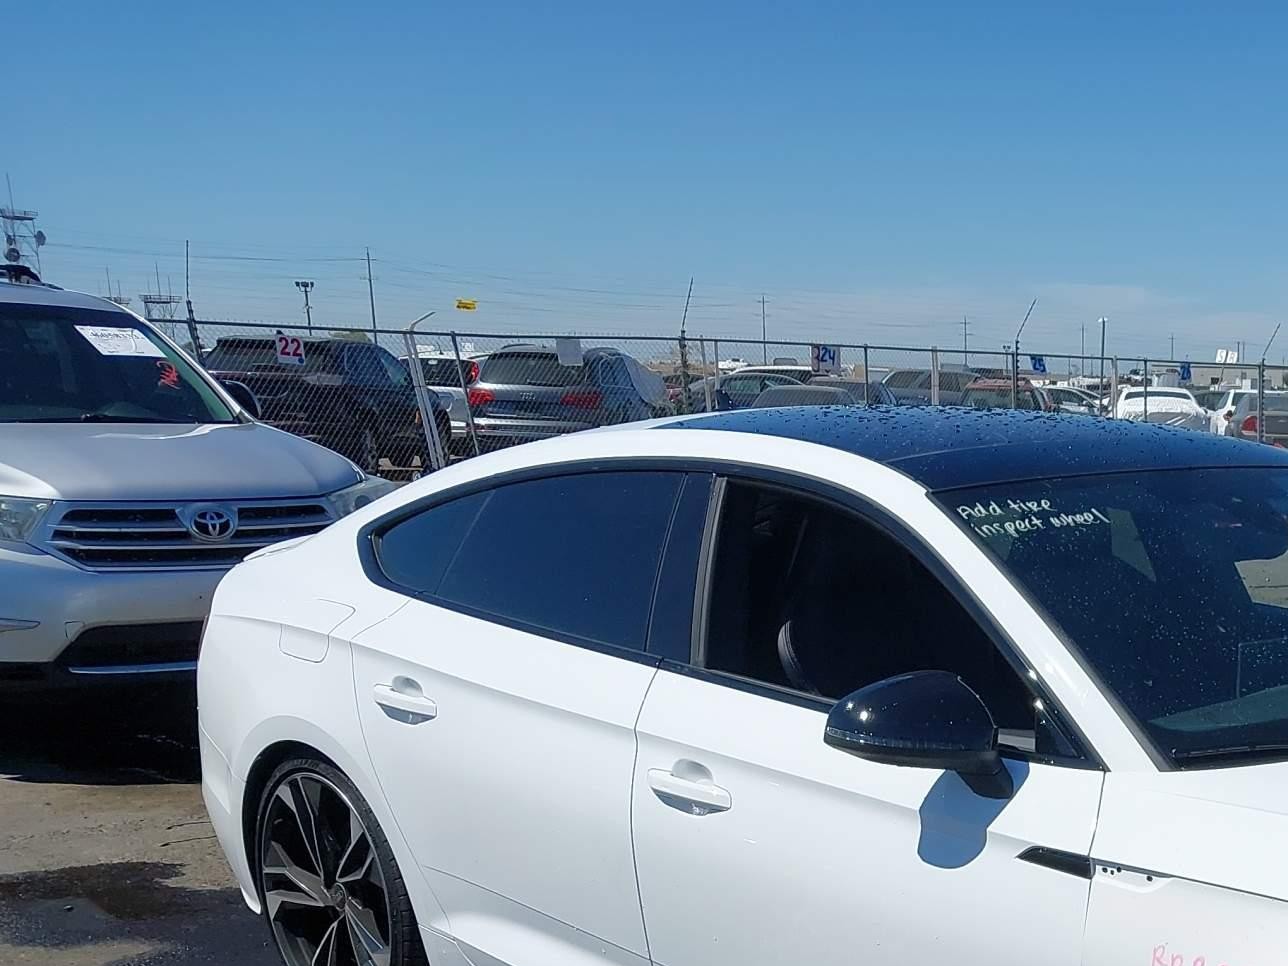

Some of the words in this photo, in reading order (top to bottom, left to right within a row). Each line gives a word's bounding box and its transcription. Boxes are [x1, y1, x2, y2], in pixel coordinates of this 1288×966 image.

[279, 337, 303, 357] 22
[821, 347, 836, 366] 24
[957, 501, 1004, 520] Add
[970, 516, 1047, 538] inspect
[1050, 507, 1112, 528] wheel
